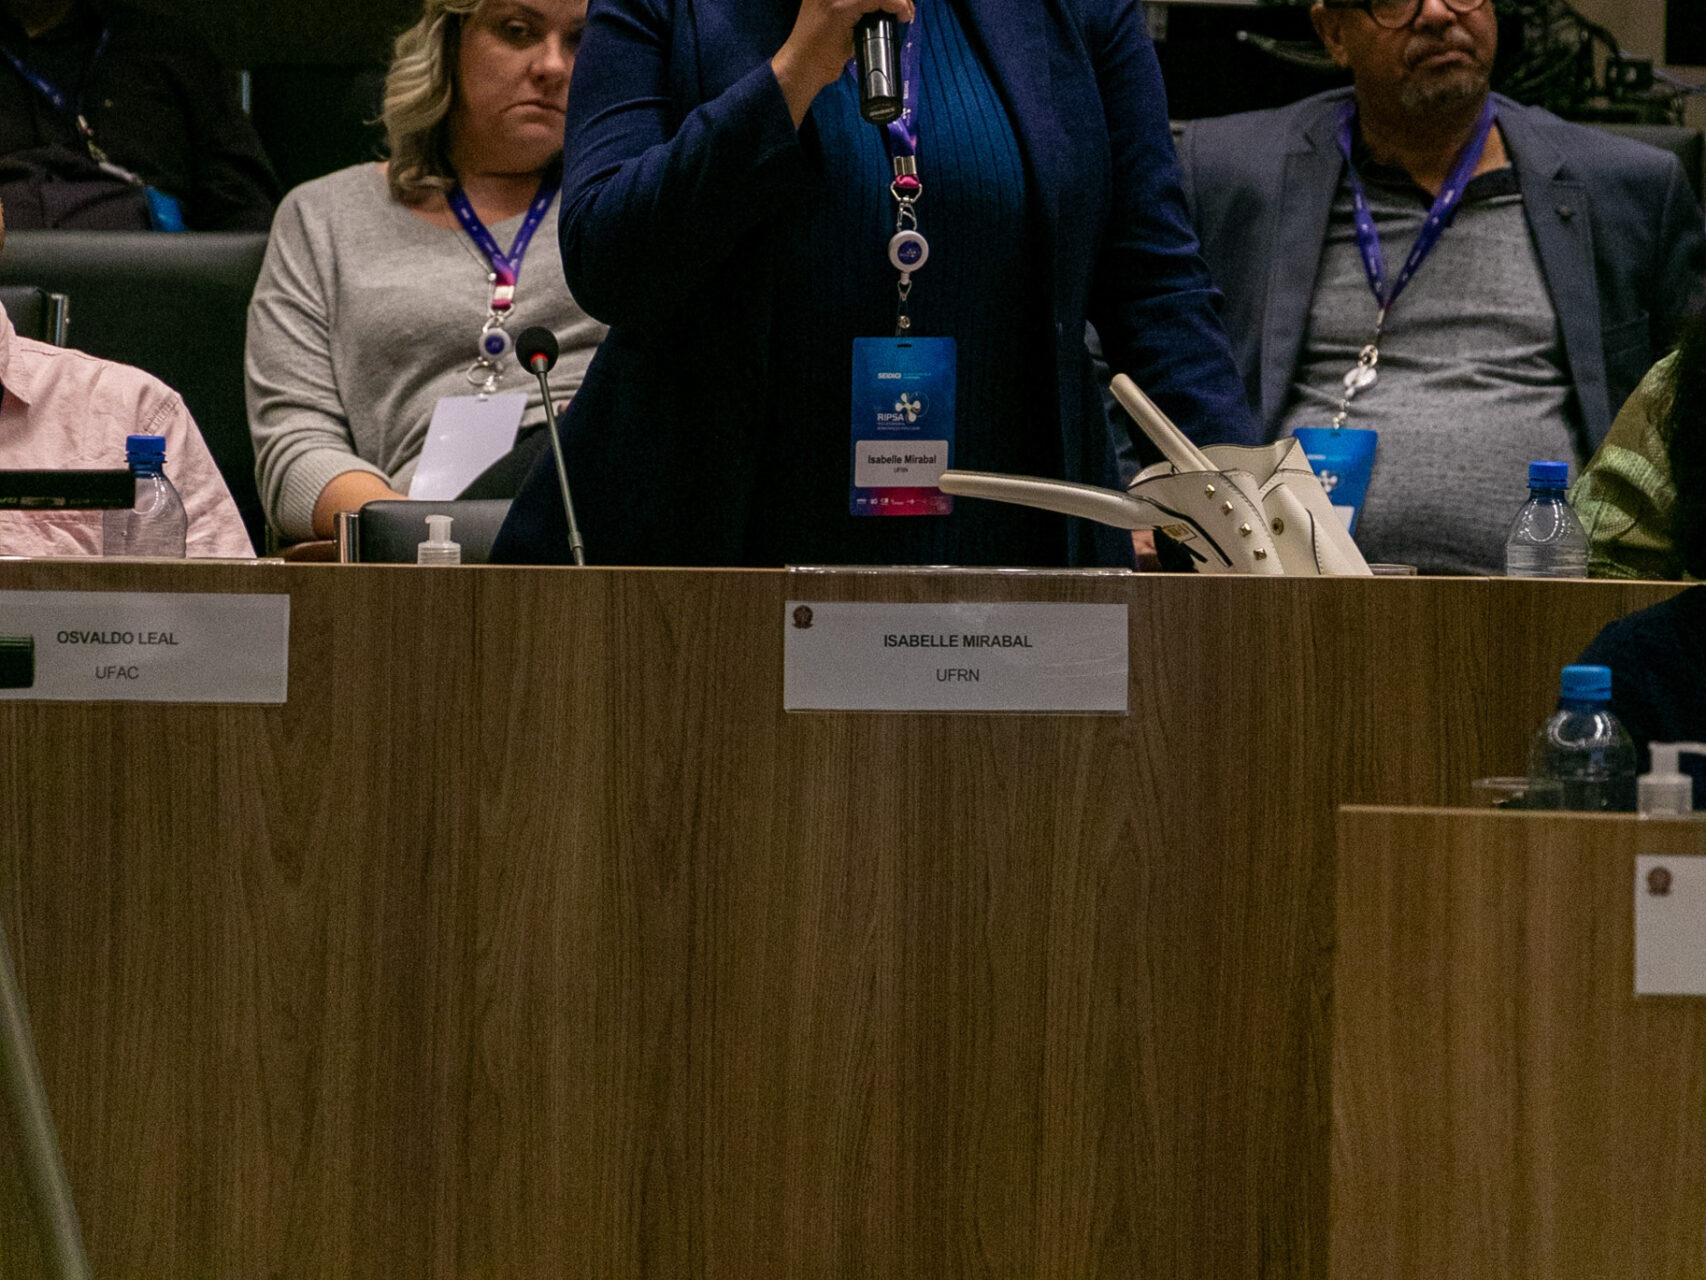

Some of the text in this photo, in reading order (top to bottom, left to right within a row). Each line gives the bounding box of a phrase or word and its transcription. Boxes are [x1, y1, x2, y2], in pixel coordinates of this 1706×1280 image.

[877, 413, 904, 421] RIPSA
[868, 454, 937, 464] Isabelle Mirabal
[57, 631, 179, 645] OSVALDO LEAL
[884, 634, 1033, 648] ISABELLE MIRABAL
[95, 665, 140, 679] UFAC
[936, 668, 980, 682] UFRN
